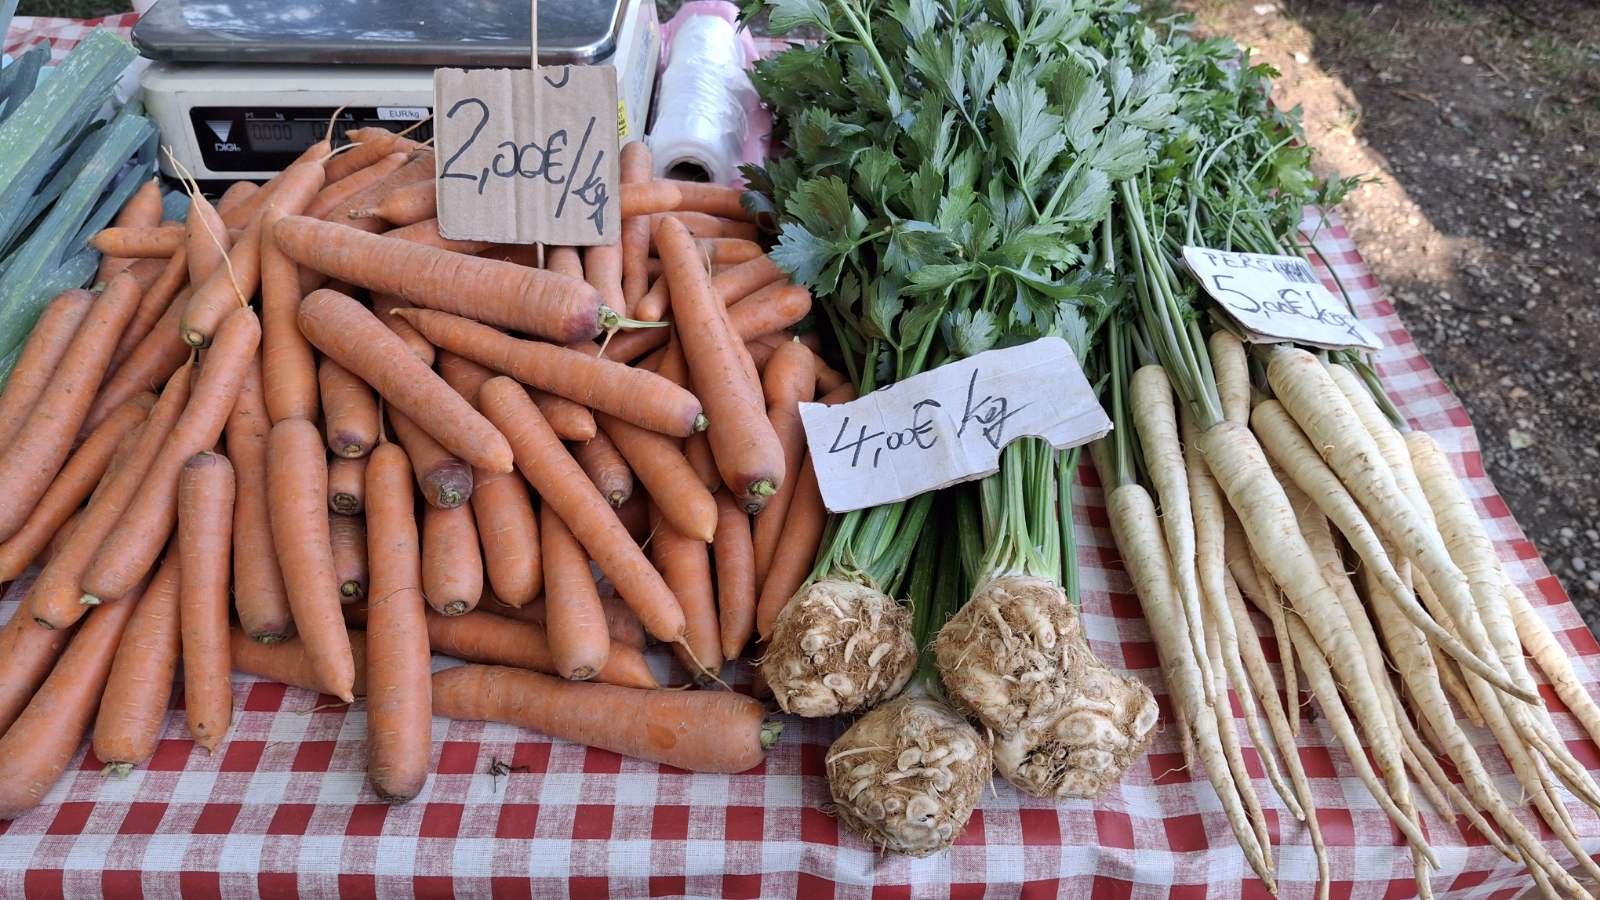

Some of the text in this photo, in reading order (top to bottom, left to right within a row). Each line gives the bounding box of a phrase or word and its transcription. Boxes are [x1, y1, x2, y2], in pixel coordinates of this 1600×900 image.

[388, 108, 420, 119] EUR/kg
[439, 97, 609, 237] 2,00€/kg
[828, 398, 942, 468] 4,00€
